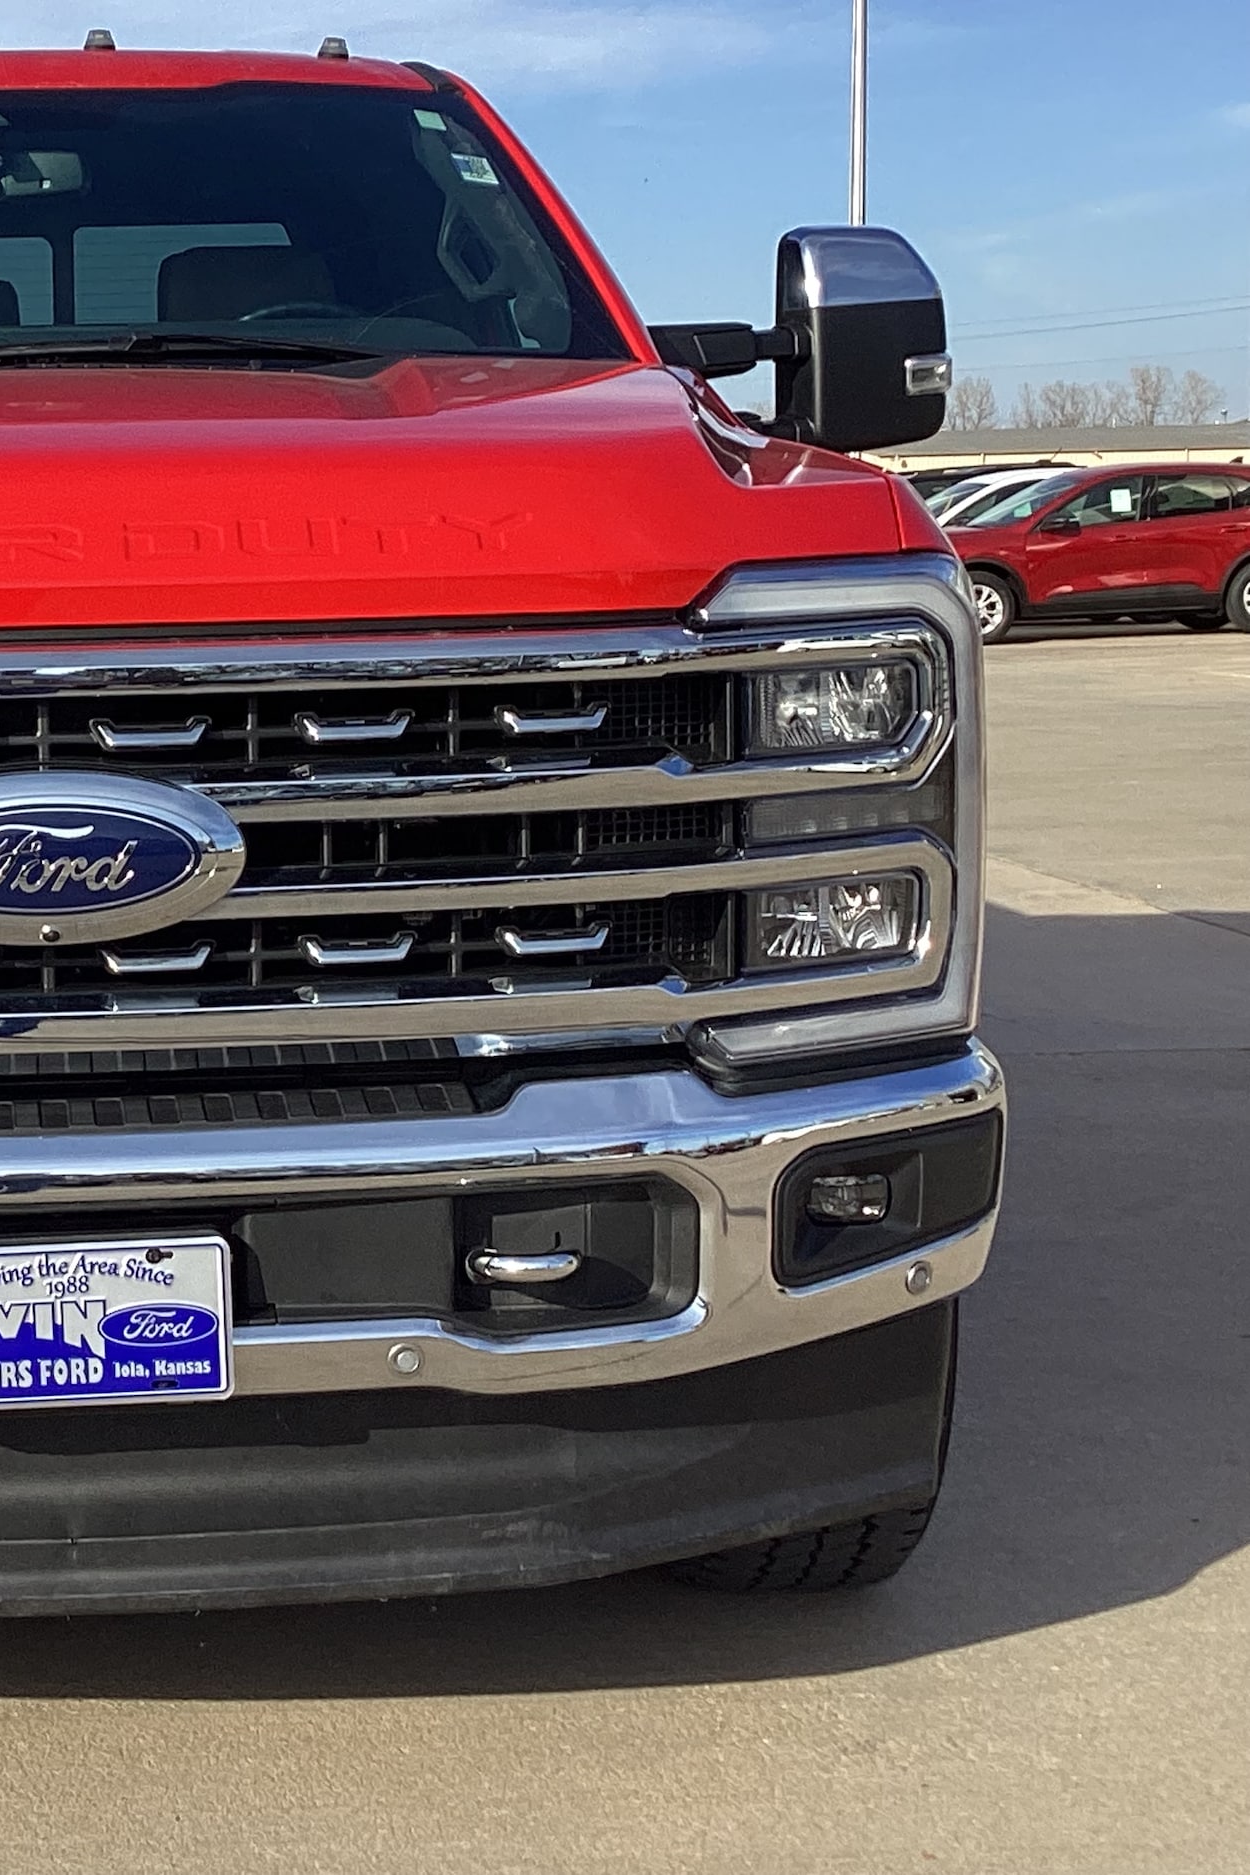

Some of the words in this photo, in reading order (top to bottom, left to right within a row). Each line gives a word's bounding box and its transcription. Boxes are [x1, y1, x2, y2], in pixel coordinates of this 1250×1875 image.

[122, 513, 533, 561] DUTY
[38, 1253, 69, 1277] the
[73, 1253, 120, 1277] Area
[124, 1259, 175, 1286] Since
[47, 1275, 90, 1299] 1988
[122, 1310, 194, 1338] Ford
[39, 1356, 105, 1386] FORD
[113, 1362, 150, 1379] Iola,
[154, 1358, 211, 1377] Kansas
